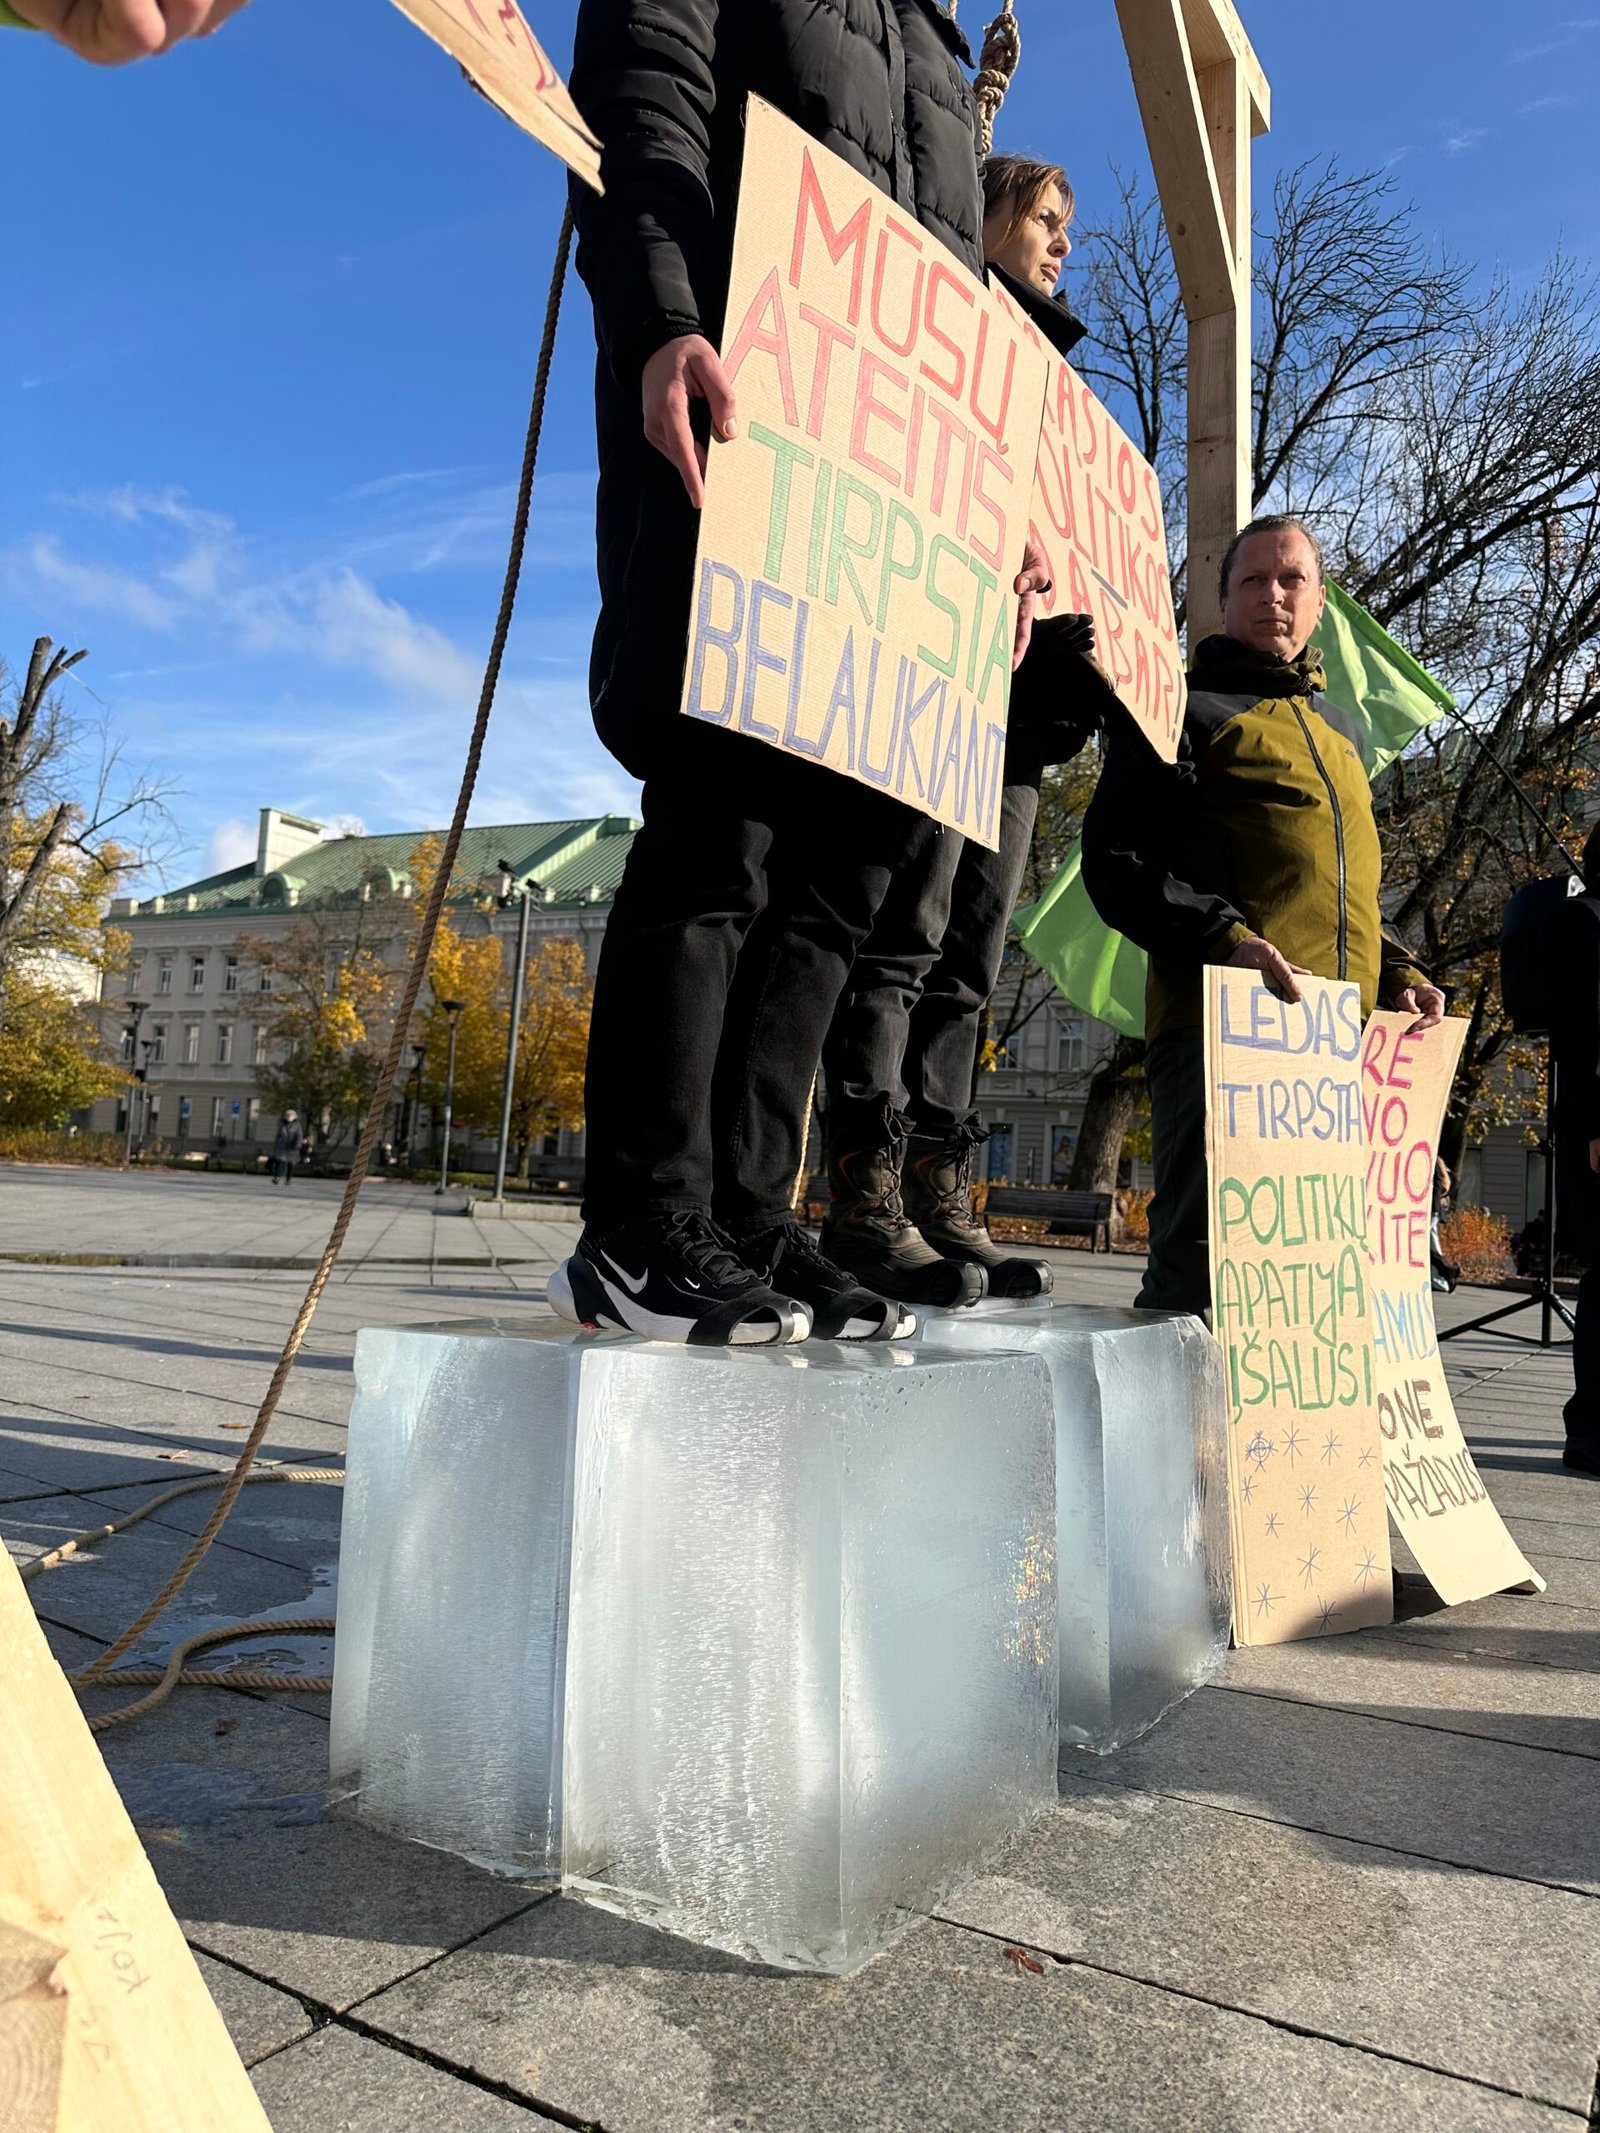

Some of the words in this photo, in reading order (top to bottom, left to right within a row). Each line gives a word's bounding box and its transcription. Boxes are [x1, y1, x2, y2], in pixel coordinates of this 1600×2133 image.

[789, 145, 1016, 454] MŪSŲ
[722, 265, 1014, 572] ATEITIS
[748, 421, 1009, 724] TIRPSTA
[1036, 425, 1173, 642] OLITIKOS
[1221, 984, 1361, 1062] LEDAS
[1217, 1076, 1363, 1146] TIRPSTA
[1219, 1173, 1369, 1252] POLITIKŲ
[1367, 1204, 1428, 1268] ITE
